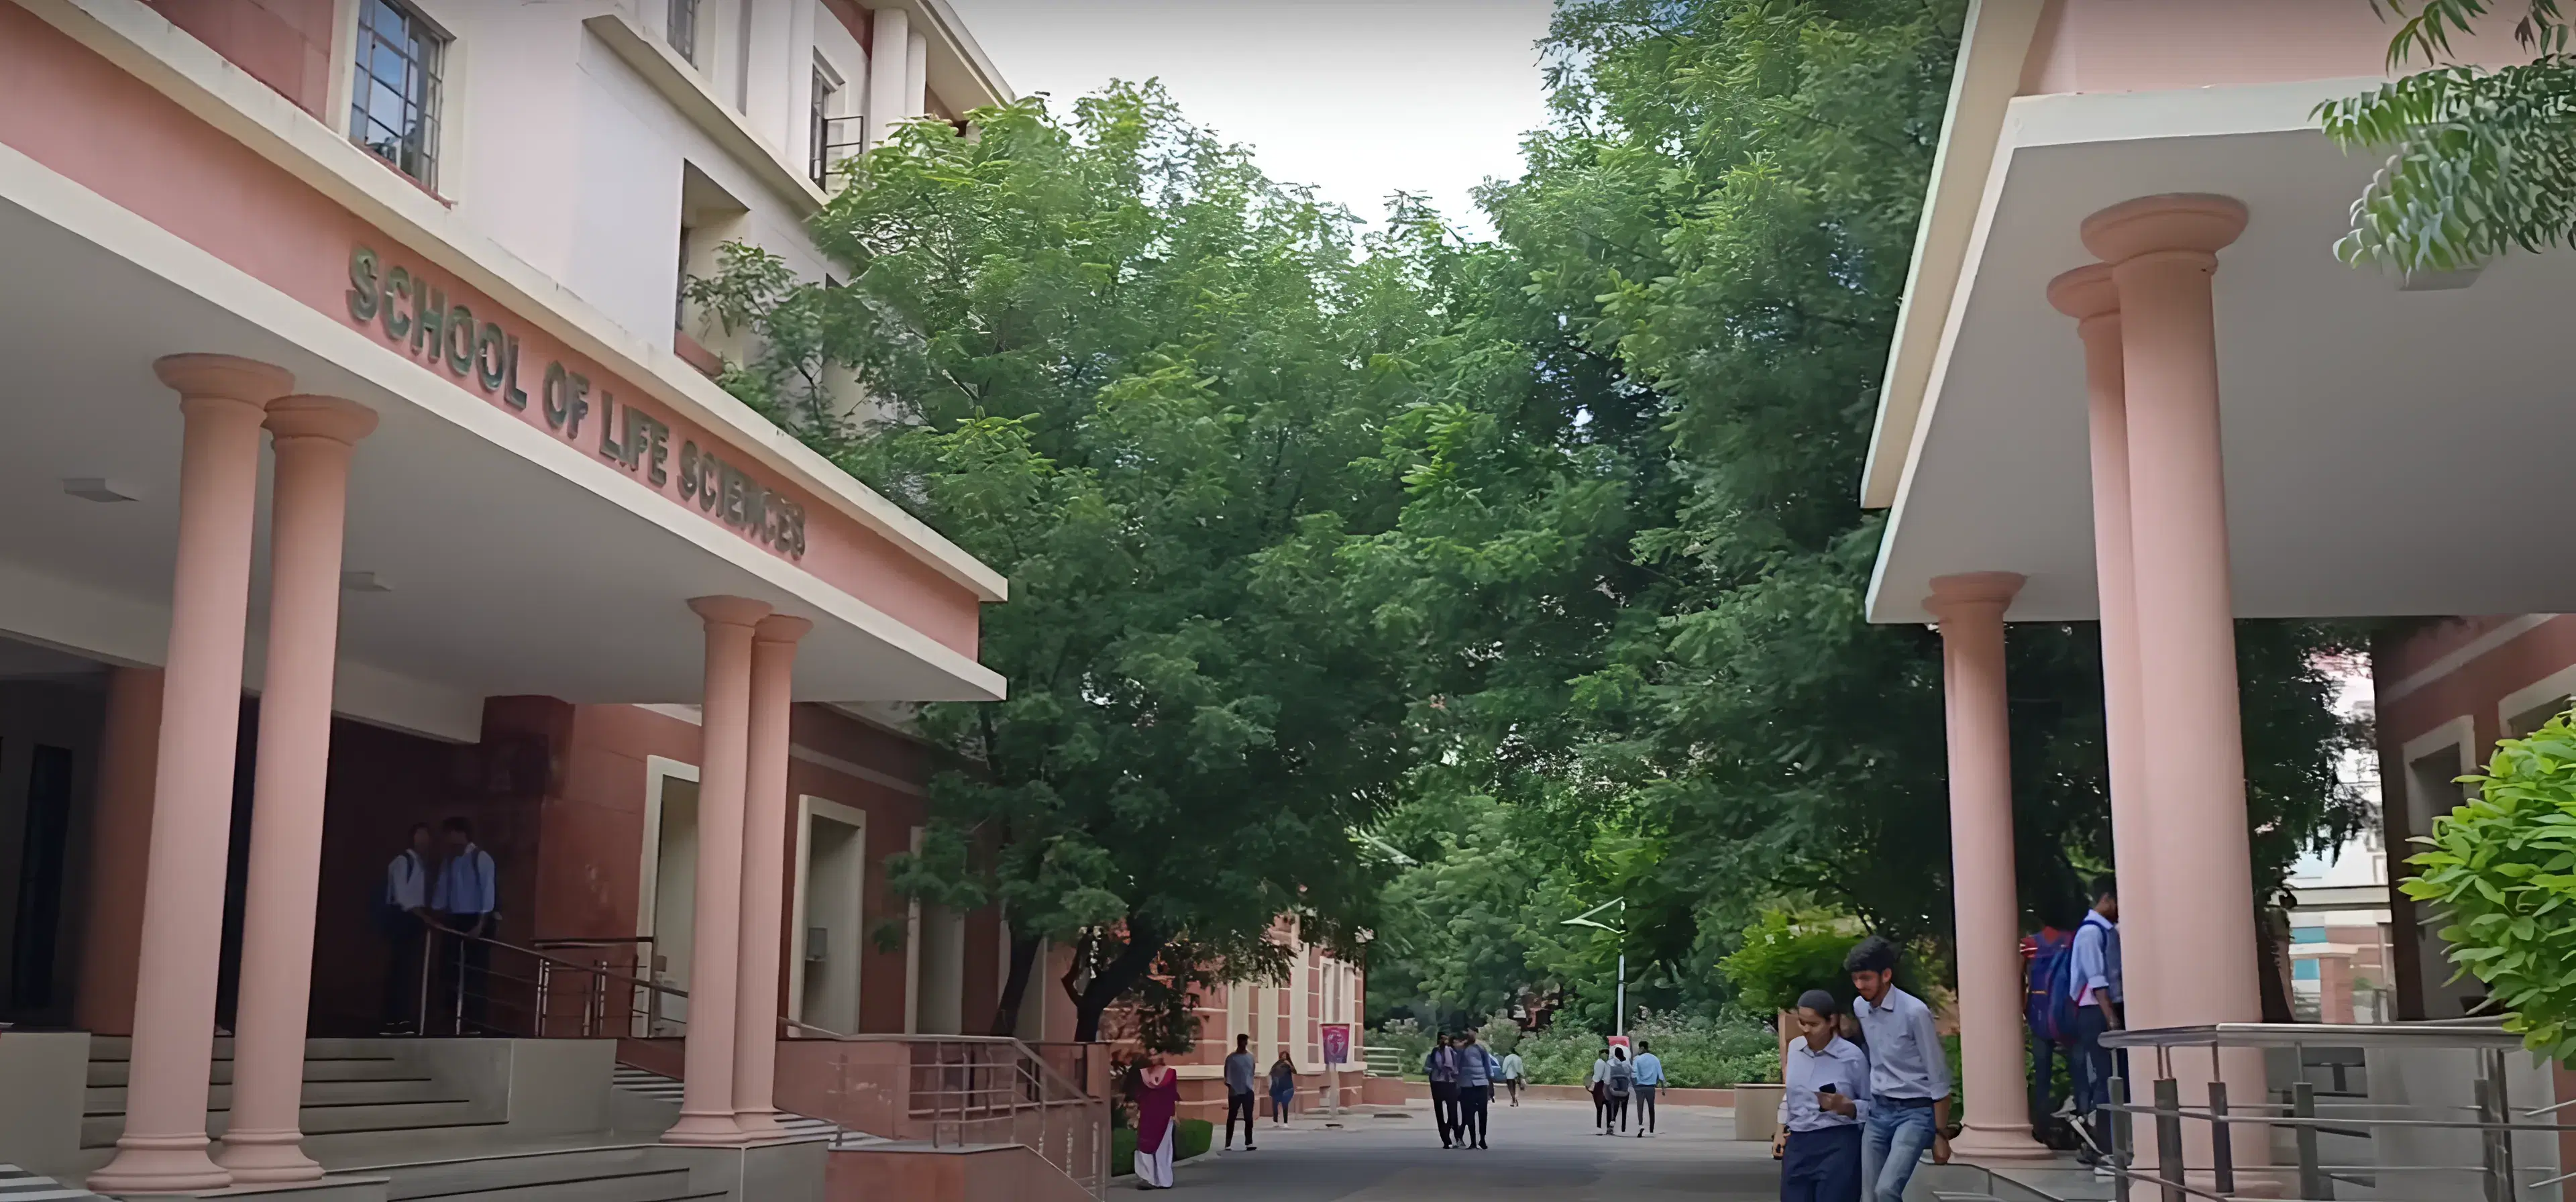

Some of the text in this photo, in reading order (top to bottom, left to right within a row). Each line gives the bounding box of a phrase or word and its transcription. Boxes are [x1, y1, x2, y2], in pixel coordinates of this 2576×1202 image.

[346, 245, 527, 412] SCHOOL
[542, 361, 590, 440] OF
[599, 389, 669, 488] LIFE
